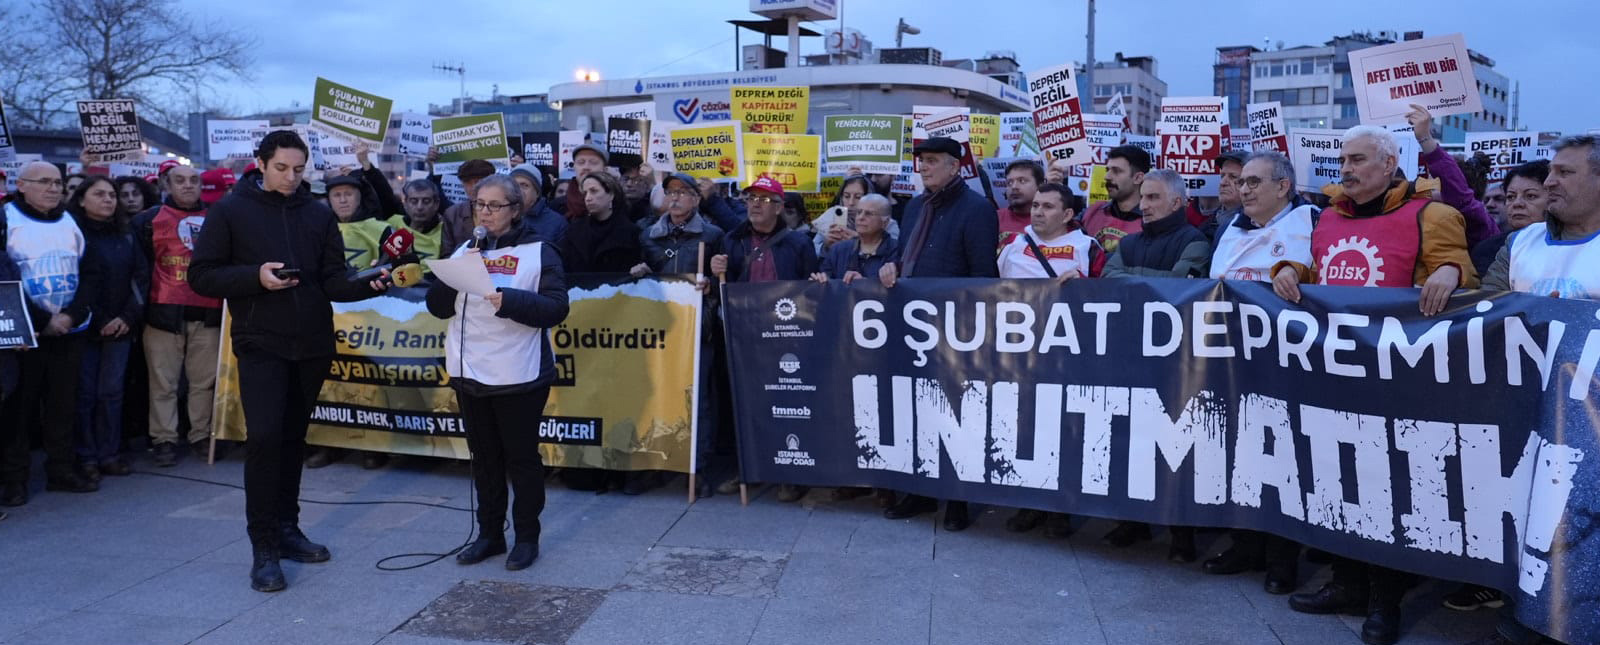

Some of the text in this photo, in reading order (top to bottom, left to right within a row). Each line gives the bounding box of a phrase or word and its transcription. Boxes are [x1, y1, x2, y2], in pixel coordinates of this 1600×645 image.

[1367, 57, 1458, 84] AFET DEĞİL BU BİR
[1030, 69, 1070, 92] DEPREM
[328, 87, 335, 96] 6
[735, 87, 804, 98] DEPREM DEĞİL
[1033, 83, 1071, 109] DEĞİL
[1390, 80, 1437, 100] KATLİAM
[79, 102, 133, 113] DEPREM
[334, 98, 365, 115] HESABI
[701, 101, 731, 112] ÇÖZÜM
[741, 100, 797, 111] KAPİTALİZM
[90, 112, 127, 126] DEĞİL
[321, 108, 376, 129] SORULACAK!
[745, 112, 795, 122] ÖLDÜRÜR!
[1037, 103, 1072, 122] YAĞMA
[1164, 115, 1217, 123] ACIMIZ HALA
[1249, 107, 1278, 123] DEPREM
[83, 126, 109, 134] RANT
[835, 118, 892, 129] YENİDEN İNŞA
[1036, 114, 1080, 136] DÜZENİNİZ
[1178, 124, 1199, 132] TAZE
[1251, 120, 1279, 139] DEĞİL
[85, 133, 139, 144] HESABINI
[435, 123, 496, 143] UNUTMAK YOK
[610, 129, 641, 141] ASLA
[671, 136, 704, 148] DEPREM
[707, 131, 733, 144] DEĞİL
[848, 129, 873, 139] DEĞİL
[438, 136, 502, 154] AFFETMEK YOK!
[525, 143, 552, 152] ASLA
[609, 140, 641, 148] UNUTMA
[831, 143, 893, 152] YENİDEN TALAN
[1165, 135, 1214, 156] AKP
[1301, 137, 1331, 150] Savaşa
[1471, 137, 1531, 151] DEPREM
[103, 153, 126, 161] EHP
[673, 146, 722, 159] KAPİTALİZM
[1052, 147, 1074, 160] SEP
[1489, 149, 1528, 166] EĞİL
[1164, 155, 1215, 173] İSTİFA!
[1311, 154, 1342, 165] Deprem
[1315, 167, 1340, 178] BÜTÇE!
[1328, 259, 1367, 281] DİSK
[26, 273, 78, 296] KES
[334, 324, 666, 350] eğil, Rant Öldürdü!
[853, 300, 888, 349] 6
[903, 300, 1121, 367] ŞUBAT
[330, 360, 450, 386] ayanışmay
[771, 405, 811, 416] tmmob
[311, 405, 354, 424] ANBUL
[357, 410, 393, 430] EMEK,
[396, 414, 435, 434] BARIŞ
[438, 417, 456, 432] VE
[538, 419, 595, 442] GÜÇLERİ
[777, 450, 810, 459] İSTANBUL
[793, 458, 815, 466] ODASI
[852, 374, 1584, 597] UNUTMADIK!
